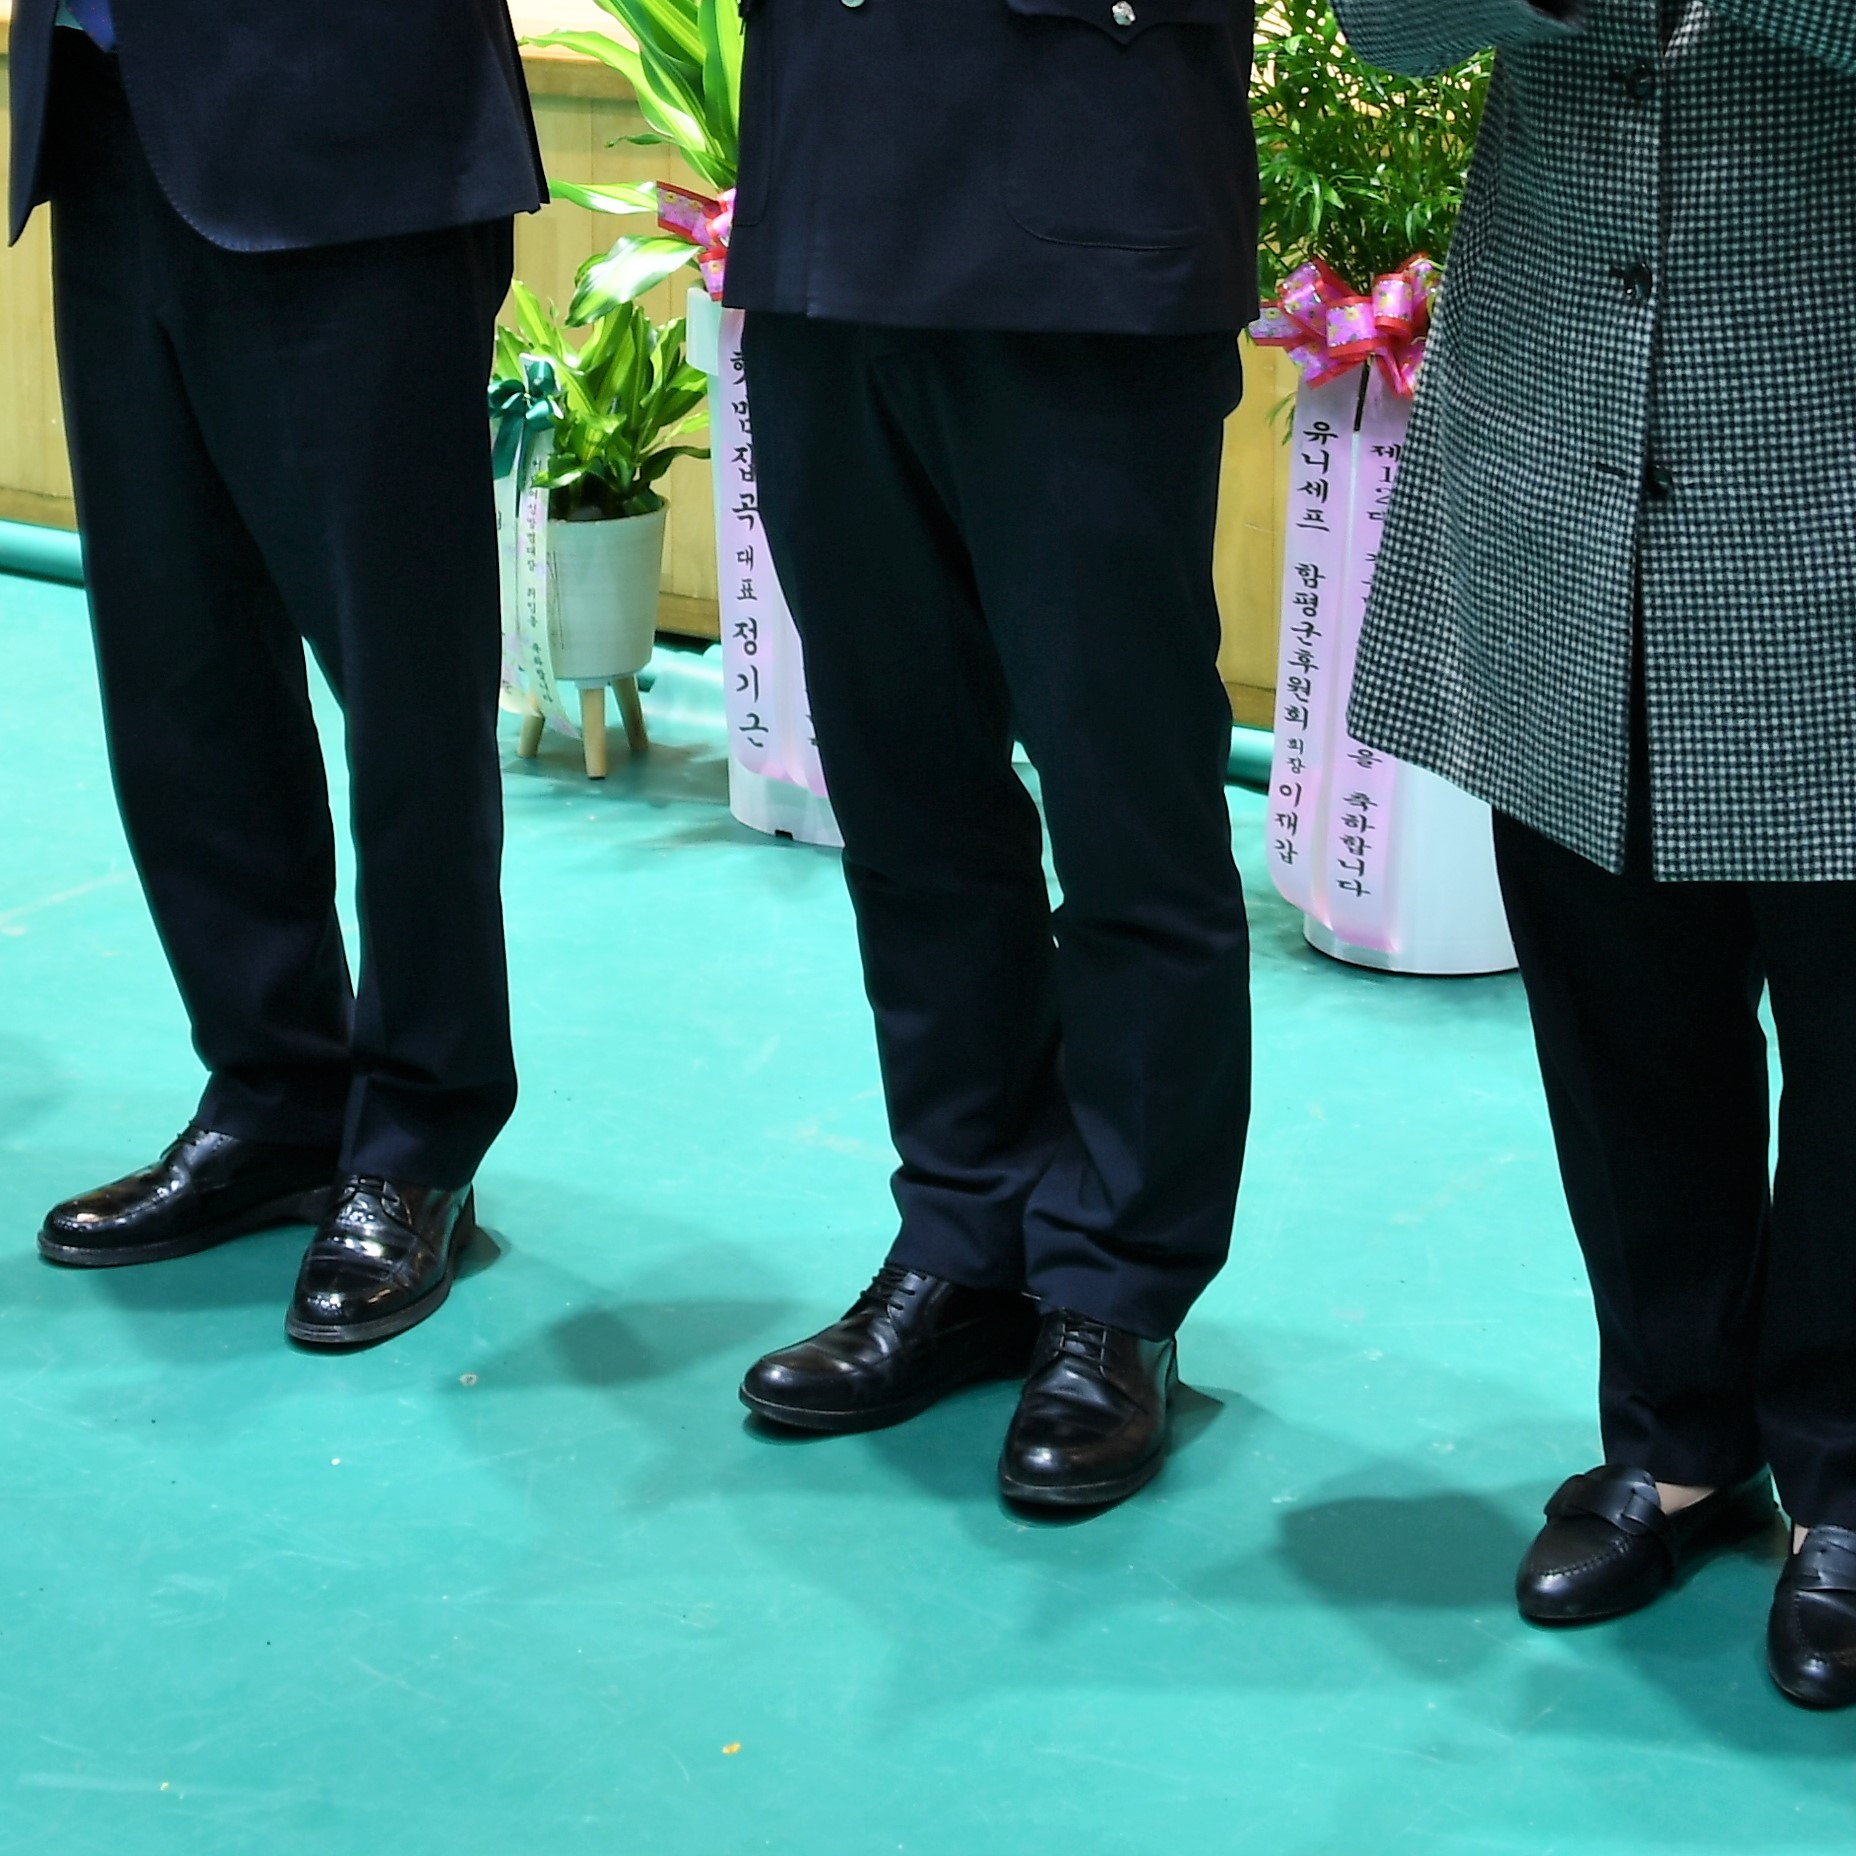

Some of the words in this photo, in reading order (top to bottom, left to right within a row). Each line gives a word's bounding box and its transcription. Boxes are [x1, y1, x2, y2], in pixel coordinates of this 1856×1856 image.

[1296, 421, 1339, 532] 유니세프
[736, 545, 758, 601] 대표
[732, 617, 769, 748] 정기근
[1284, 562, 1326, 731] 함평군후원회
[1336, 791, 1379, 898] 축하합니다
